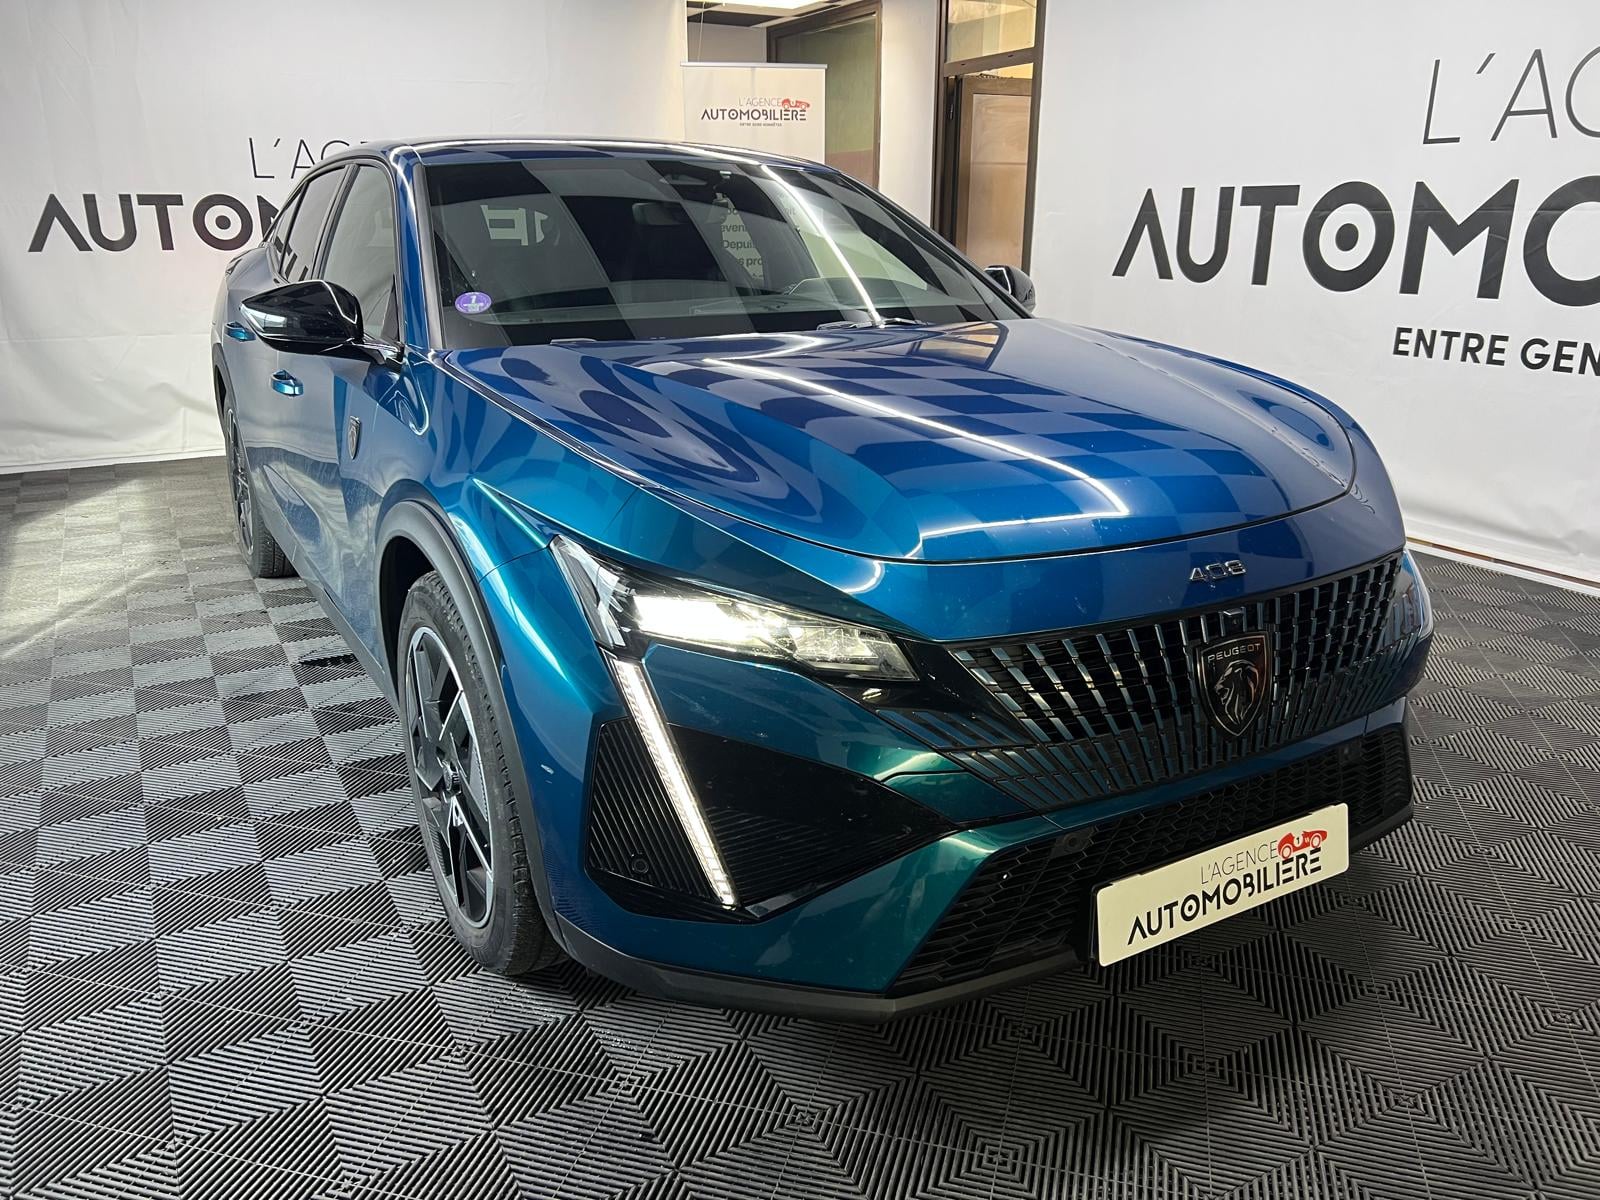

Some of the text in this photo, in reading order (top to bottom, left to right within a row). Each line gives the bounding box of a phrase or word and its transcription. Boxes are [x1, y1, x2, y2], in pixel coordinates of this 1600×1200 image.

[738, 97, 782, 107] L'AGENCE
[1111, 175, 1600, 308] AUTOMO
[1393, 326, 1600, 377] ENTRE GEN
[1189, 559, 1246, 582] 408
[1207, 642, 1261, 665] PEUGEOT
[1201, 840, 1279, 885] L'AGENCE
